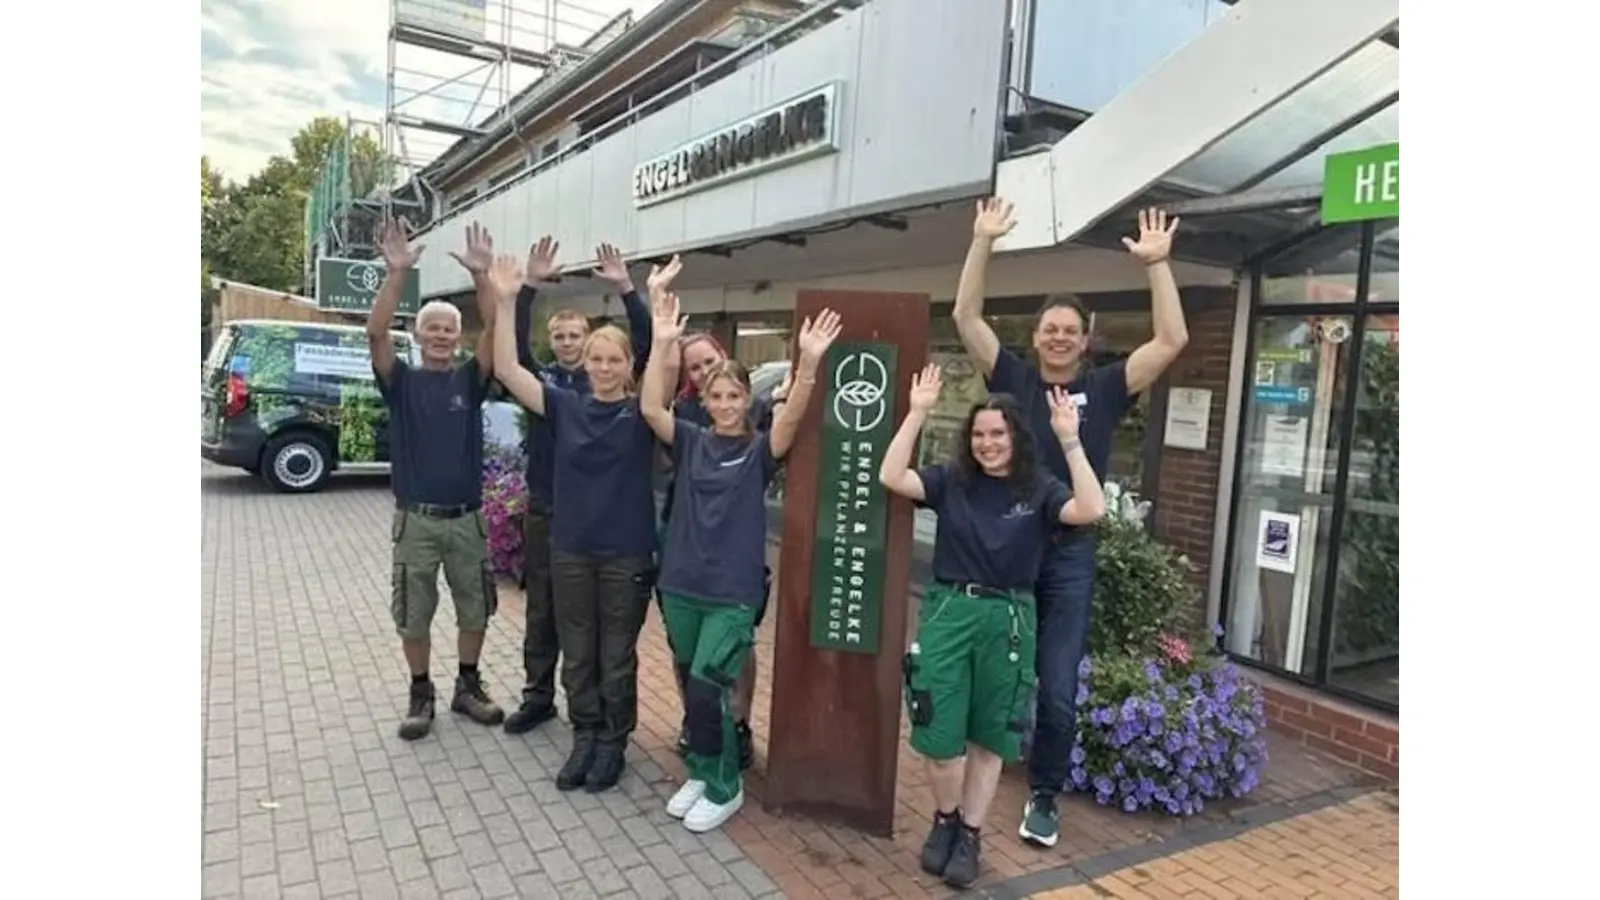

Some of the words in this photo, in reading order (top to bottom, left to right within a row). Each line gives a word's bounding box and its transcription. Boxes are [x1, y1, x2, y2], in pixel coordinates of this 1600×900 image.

[839, 440, 852, 473] WIR
[855, 441, 872, 510] ENGEL
[833, 480, 851, 567] PFLANZEN
[853, 521, 867, 534] &
[827, 575, 844, 641] FREUDE
[846, 546, 866, 644] ENGELKE
